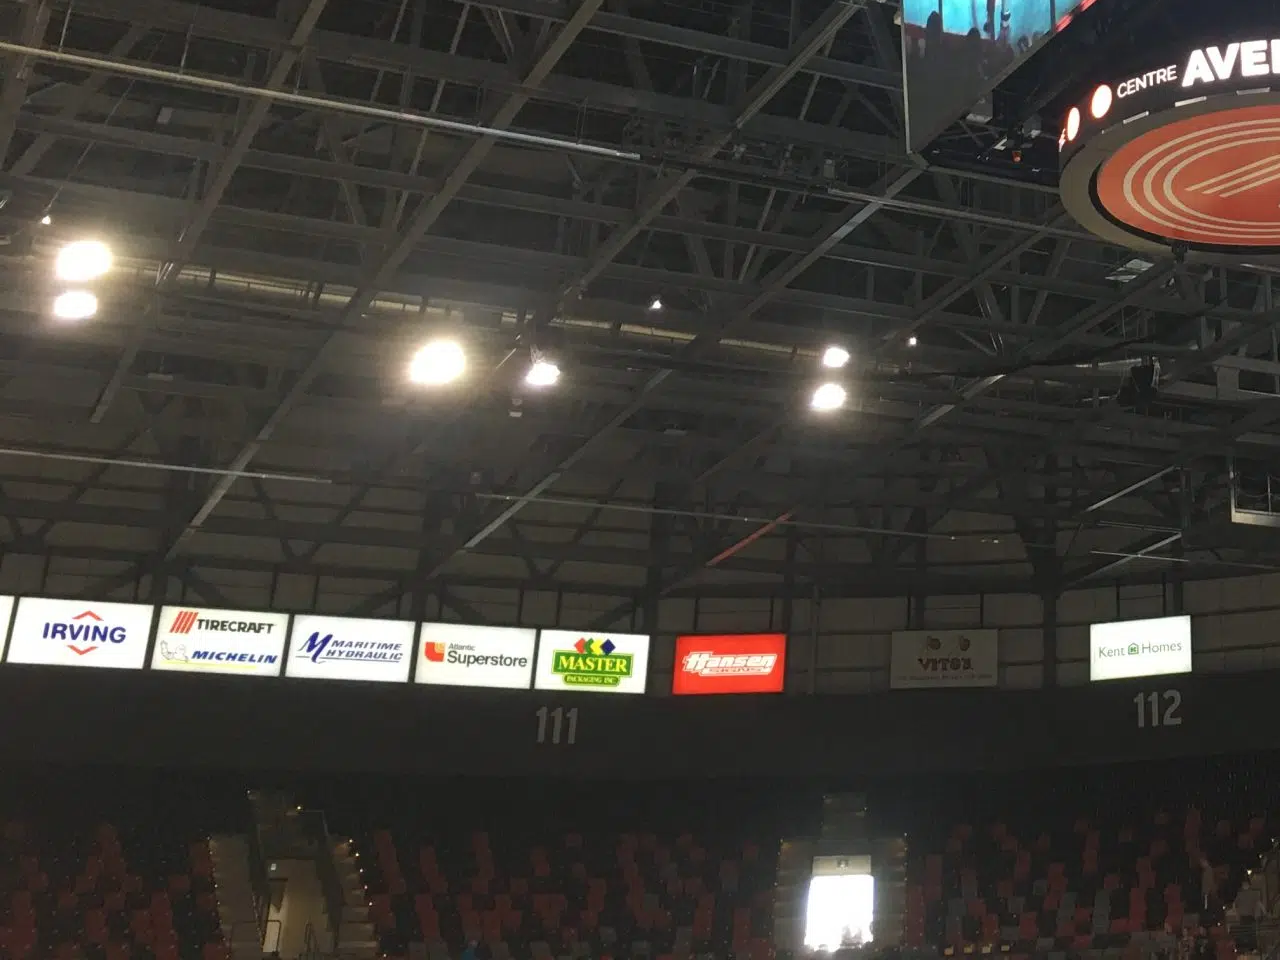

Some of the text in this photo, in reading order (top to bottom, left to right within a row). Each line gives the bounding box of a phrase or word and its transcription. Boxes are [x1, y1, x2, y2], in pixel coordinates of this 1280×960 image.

[1116, 64, 1177, 99] CENTRE
[42, 622, 126, 644] IRVING
[197, 619, 275, 634] TIRECRAFT
[331, 640, 403, 651] MARITIME
[448, 643, 475, 651] Atlantic
[1098, 641, 1182, 658] Kent Homes
[191, 650, 278, 664] MICHELIN
[326, 649, 403, 660] HYDRAULIC
[447, 651, 528, 667] Superstore
[684, 652, 776, 671] Hansen
[558, 655, 627, 672] MASTER
[1133, 689, 1182, 728] 112
[536, 706, 578, 744] 111
